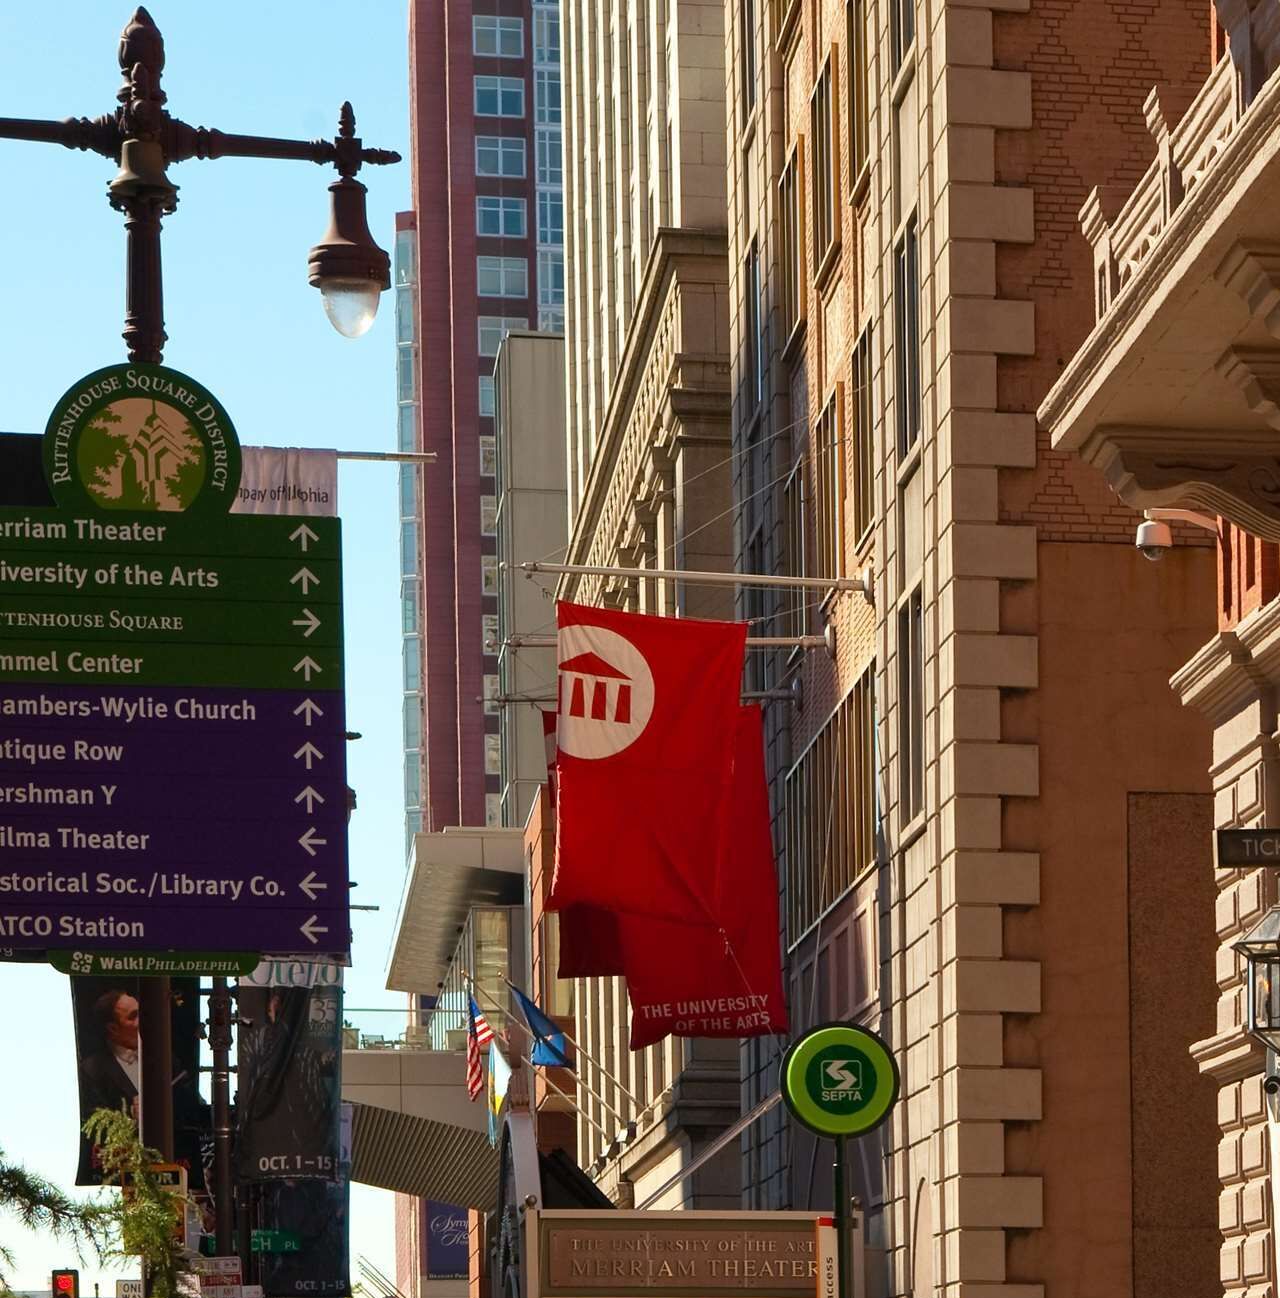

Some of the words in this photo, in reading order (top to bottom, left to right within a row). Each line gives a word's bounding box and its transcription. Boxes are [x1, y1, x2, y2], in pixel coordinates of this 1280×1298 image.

[51, 376, 122, 486] RITTENHOUSE
[126, 369, 198, 409] SQUARE
[195, 402, 228, 492] DISTRICT
[73, 518, 167, 542] Theater
[94, 563, 119, 584] of
[124, 564, 163, 586] the
[169, 566, 219, 588] Arts
[108, 610, 184, 632] SQUARE
[67, 651, 144, 674] Center
[174, 698, 256, 721] Church
[0, 738, 66, 765] tique
[74, 740, 124, 761] Row
[100, 784, 117, 805] Y
[57, 827, 150, 849] Theater
[96, 872, 244, 900] Soc./Library
[249, 875, 286, 897] Co.
[59, 916, 145, 937] Station
[99, 957, 144, 971] Walk!
[145, 957, 241, 972] PHILADELPHIA
[641, 1003, 673, 1019] THE
[677, 994, 769, 1016] UNIVERSITY
[675, 1018, 696, 1031] OF
[700, 1017, 732, 1030] THE
[736, 1011, 770, 1030] ARTS
[821, 1090, 863, 1102] SEPTA
[259, 1155, 290, 1171] OCT.
[612, 1239, 711, 1251] UNIVERSITY
[718, 1240, 738, 1252] OF
[746, 1240, 777, 1252] THE
[571, 1259, 698, 1277] MERRIAM
[706, 1260, 818, 1278] THEATER
[295, 1280, 318, 1291] OCT.
